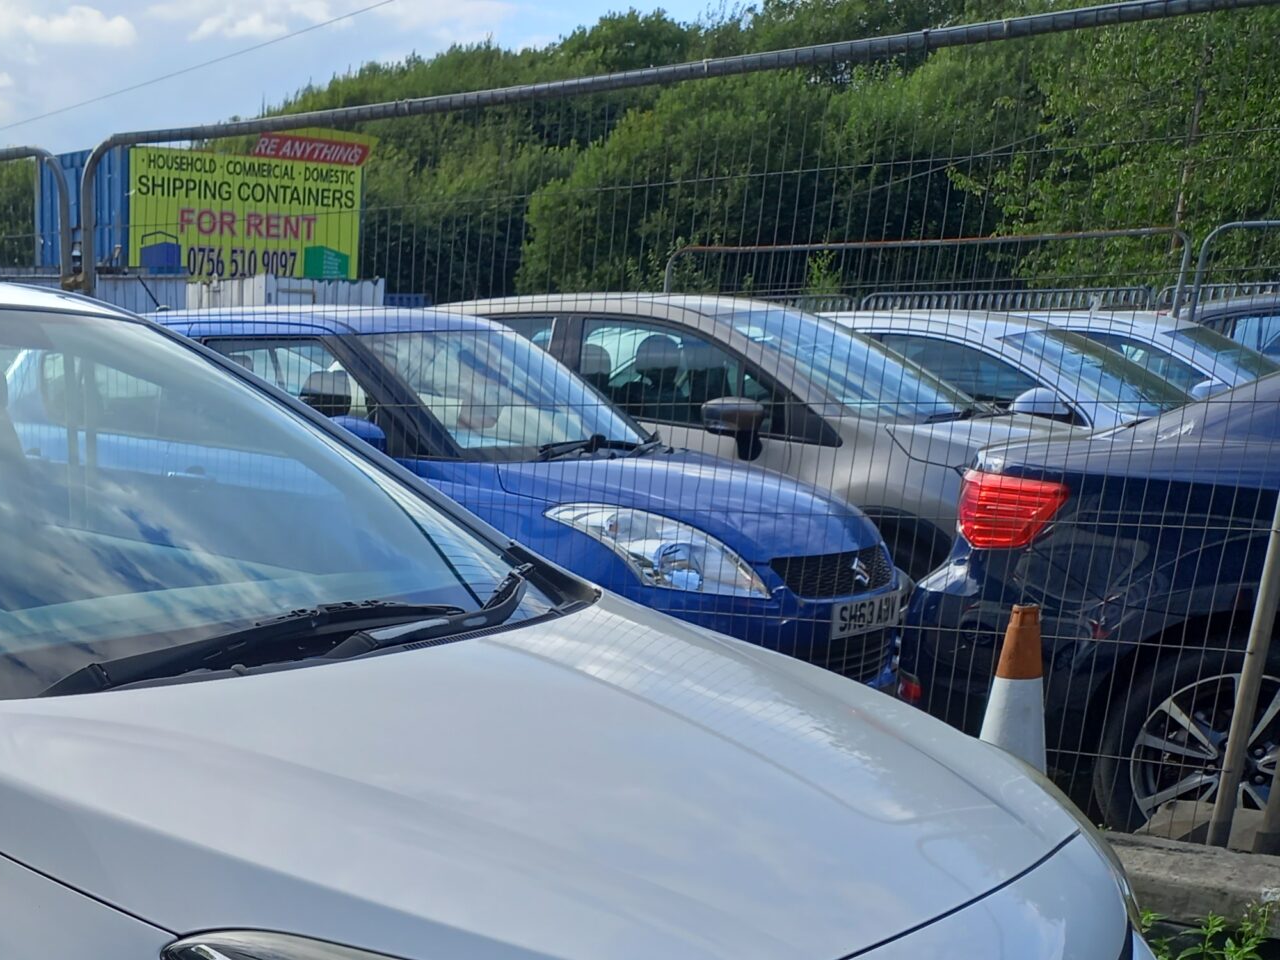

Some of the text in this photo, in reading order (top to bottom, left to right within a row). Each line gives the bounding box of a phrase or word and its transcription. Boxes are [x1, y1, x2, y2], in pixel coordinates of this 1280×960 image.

[252, 137, 362, 164] RE ANYTHING
[148, 154, 356, 186] HOUSEHOLD COMMERCIAL DOMESTIC
[138, 174, 356, 209] SHIPPING CONTAINERS
[179, 208, 318, 241] FOR RENT
[187, 247, 225, 277] 0756
[231, 248, 257, 277] 510
[839, 602, 874, 632] SH63
